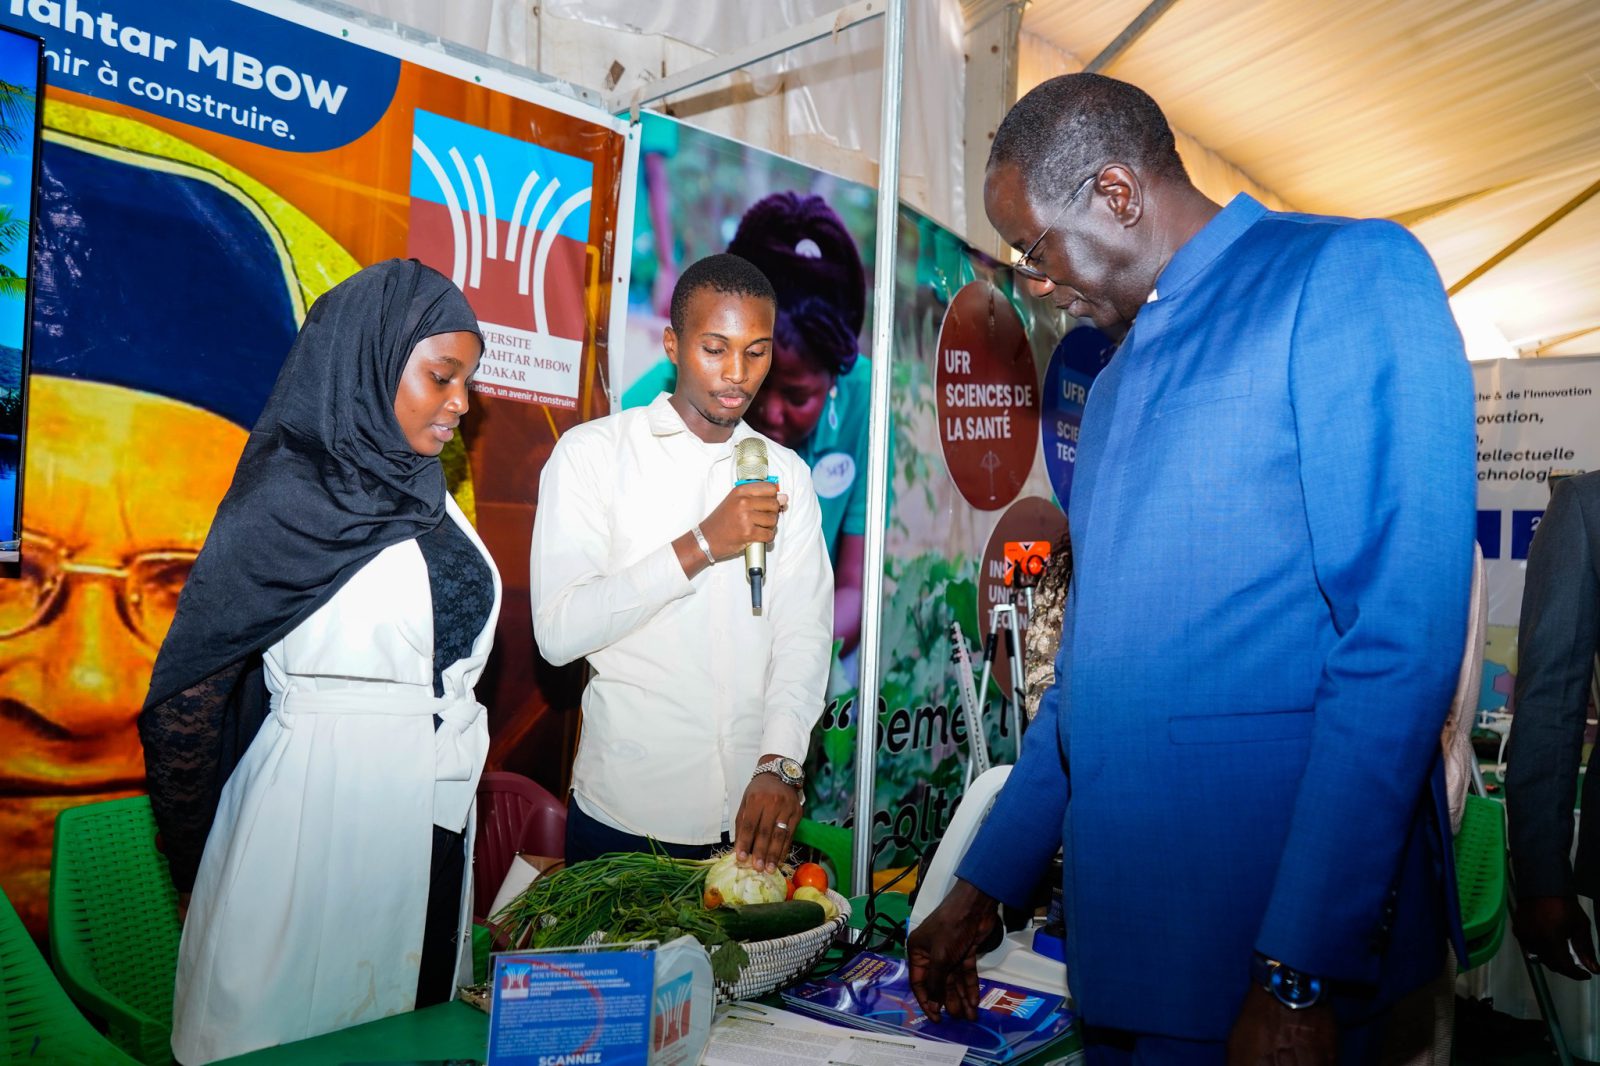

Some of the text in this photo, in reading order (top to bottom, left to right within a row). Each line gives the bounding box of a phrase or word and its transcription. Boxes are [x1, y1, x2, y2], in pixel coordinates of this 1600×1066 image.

[188, 37, 348, 115] MBOW
[97, 60, 118, 87] à
[128, 76, 296, 141] construire.
[533, 357, 572, 373] MBOW
[945, 349, 971, 375] UFR
[482, 364, 526, 382] DAKAR
[498, 388, 507, 397] un
[508, 389, 532, 400] avenir
[539, 395, 576, 408] construire
[945, 384, 1033, 408] SCIENCES DE
[1063, 379, 1086, 405] UFR
[1506, 389, 1520, 400] de
[1524, 387, 1592, 399] l'Innovation
[946, 409, 1012, 441] LA SANTÉ
[1476, 410, 1544, 425] ovation,
[1477, 448, 1575, 462] tellectuelle
[538, 1052, 602, 1066] SCANNEZ
